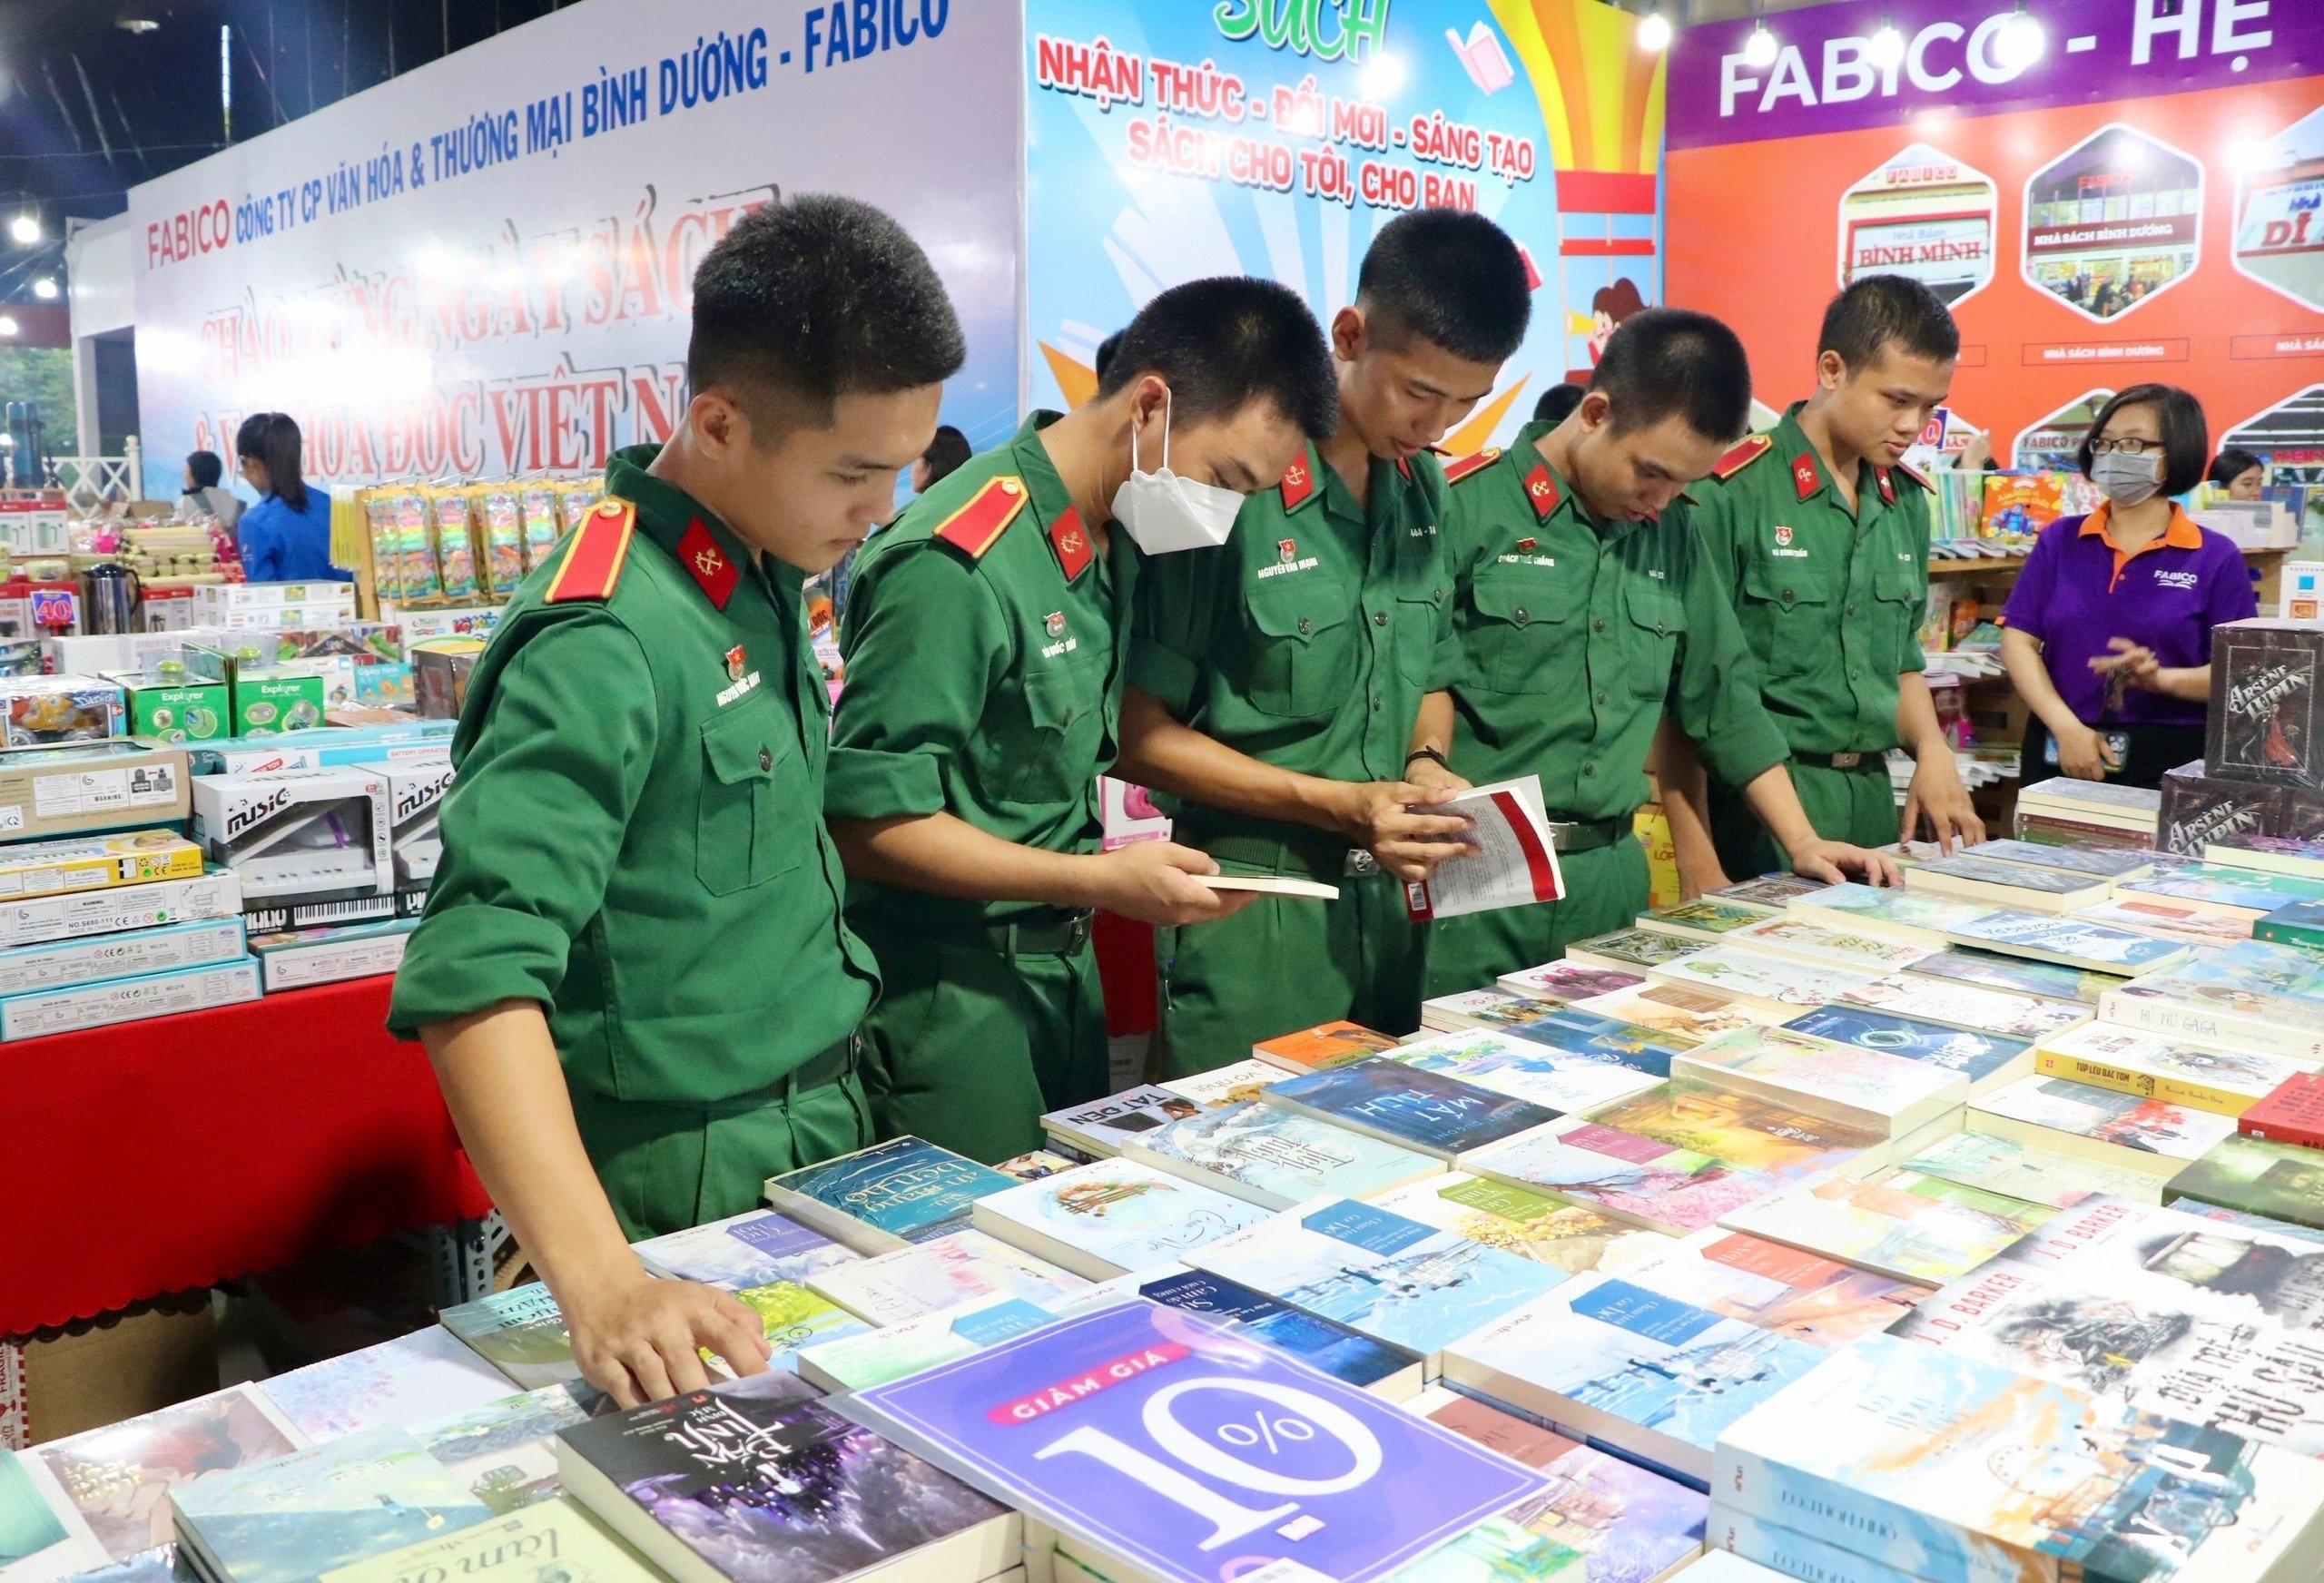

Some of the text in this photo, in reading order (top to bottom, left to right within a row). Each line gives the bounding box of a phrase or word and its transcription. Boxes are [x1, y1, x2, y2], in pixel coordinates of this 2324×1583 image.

[1718, 13, 2038, 116] FABICO
[1038, 40, 1140, 105] NHẬN
[1150, 60, 1244, 117] THỨC
[1334, 98, 1385, 145] MỚI
[1413, 111, 1481, 163] SÁNG
[1488, 135, 1533, 180] TẠO
[148, 198, 230, 271] FABICO
[235, 193, 274, 244] CÔNG
[275, 189, 296, 230] TY
[300, 181, 323, 224] CP
[327, 161, 360, 215] VĂN
[366, 142, 403, 202] HÓA
[410, 152, 424, 187] &
[430, 113, 518, 181] THƯƠNG
[527, 91, 574, 158] MẠI
[581, 66, 647, 138] BÌNH
[660, 29, 767, 115] DƯƠNG
[805, 0, 950, 73] FABICO
[1128, 118, 1217, 172] SÁCH
[1228, 144, 1291, 185] CHO
[1300, 149, 1354, 202] TÔI,
[1361, 164, 1415, 207] CHO
[2034, 233, 2062, 246] NHÀ
[2063, 231, 2094, 243] SÁCH
[2097, 228, 2127, 241] BÌNH
[2044, 347, 2066, 359] NHÀ
[2068, 345, 2096, 358] SÁCH
[489, 363, 619, 478] VIỆT
[2154, 569, 2198, 585] FABICO
[36, 601, 73, 620] 40
[2246, 674, 2311, 723] LUPIN
[2182, 1016, 2217, 1037] GAGA
[2070, 1204, 2132, 1241] BARKER
[1950, 1273, 2025, 1315] BARKER
[1012, 1342, 1170, 1421] GIẢM GIÁ
[1033, 1376, 1384, 1552] 10
